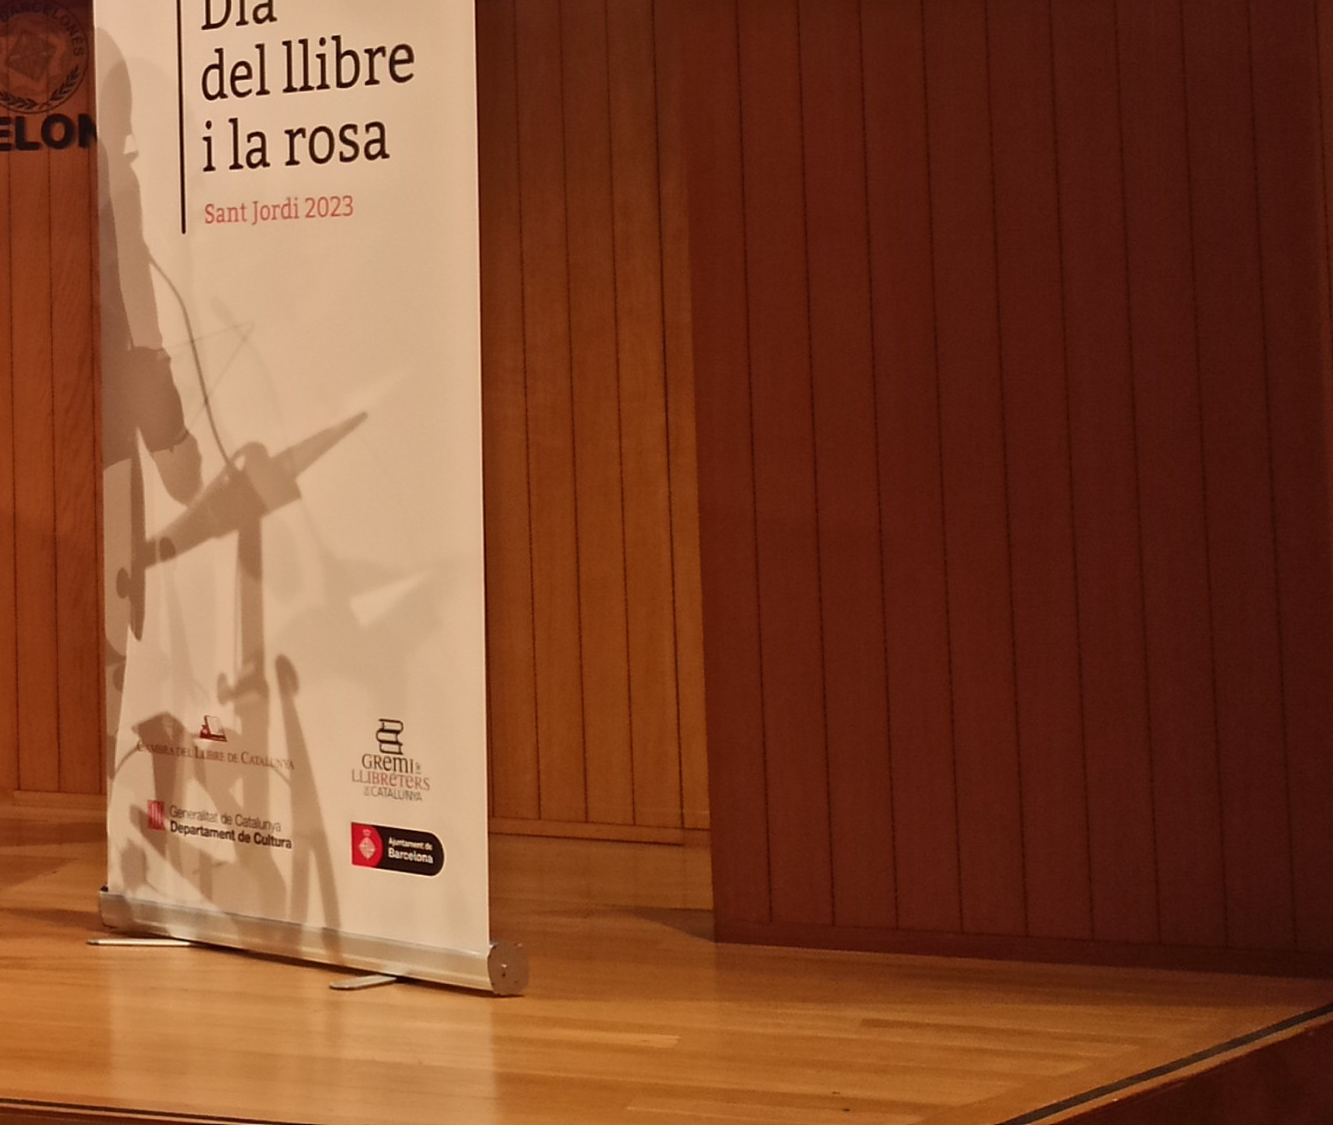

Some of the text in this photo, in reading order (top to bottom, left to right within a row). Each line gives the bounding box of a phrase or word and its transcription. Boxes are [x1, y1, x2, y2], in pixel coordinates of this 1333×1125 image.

[201, 34, 416, 102] del llibre
[202, 117, 391, 173] i la rosa
[204, 194, 355, 226] Sant Jordi 2023
[371, 785, 423, 802] CATALUNYA
[169, 804, 282, 833] Generalitat de Catalunya
[169, 820, 293, 850] Departament de Cultura
[388, 846, 434, 864] Barcelona
